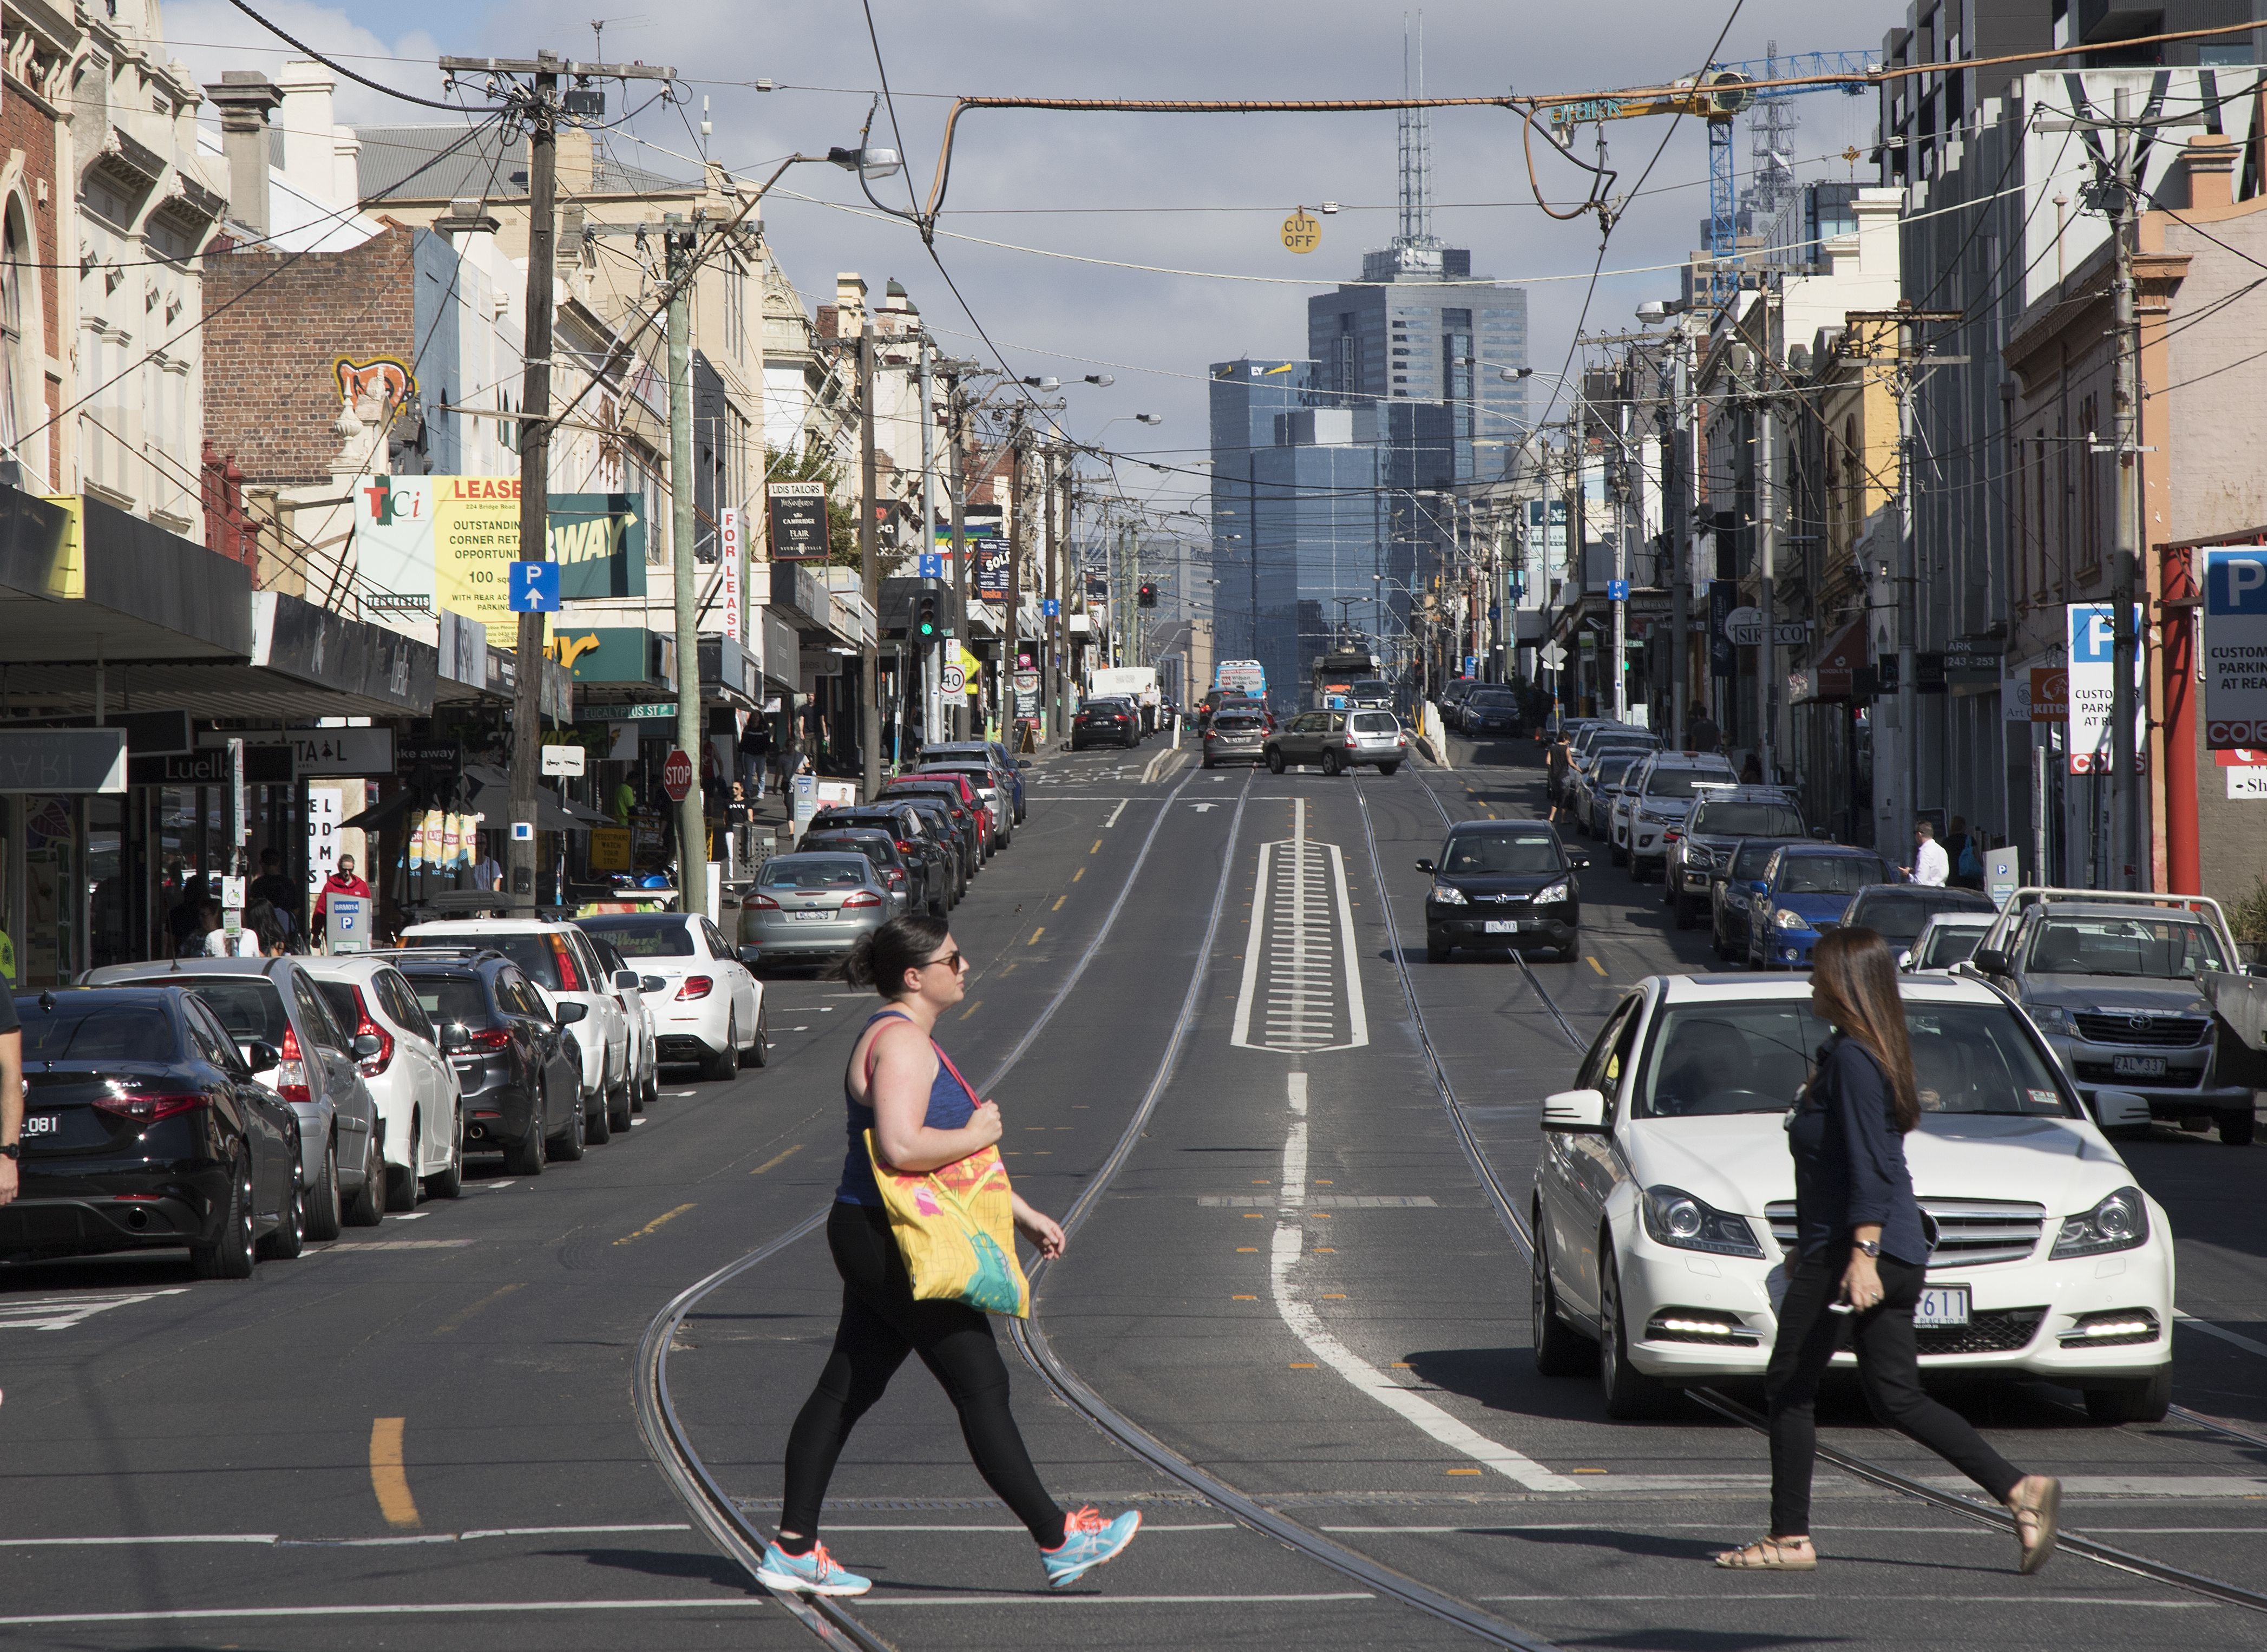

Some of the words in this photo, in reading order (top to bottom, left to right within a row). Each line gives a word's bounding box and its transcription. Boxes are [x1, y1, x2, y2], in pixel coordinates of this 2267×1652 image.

[1285, 220, 1315, 232] CUT
[1285, 235, 1315, 247] OFF
[1250, 366, 1264, 376] EY
[454, 480, 521, 499] LEASE
[791, 485, 820, 494] TAILORS
[724, 514, 735, 557] FOR
[790, 529, 810, 537] FLAIR
[449, 535, 494, 545] CORNER
[498, 535, 521, 544] RET
[927, 555, 934, 564] P
[469, 571, 493, 583] 100
[526, 566, 542, 584] P
[2228, 559, 2265, 606] P
[1739, 626, 1803, 643] SIRCCO
[2089, 615, 2114, 655] P
[1948, 657, 1967, 666] 243
[1976, 657, 1995, 666] 253
[942, 674, 960, 686] 40
[2221, 678, 2238, 689] AT
[585, 705, 644, 719] EUCALYPTUS
[647, 705, 659, 717] ST
[2006, 707, 2023, 718] Art
[2084, 717, 2096, 726] AT
[420, 750, 456, 761] away
[666, 766, 691, 785] STOP
[1999, 865, 2006, 874] P
[342, 917, 352, 929] P
[2115, 1057, 2135, 1071] ZAL
[2144, 1059, 2165, 1072] 337
[28, 1117, 57, 1132] 081
[1924, 1291, 1964, 1316] 611
